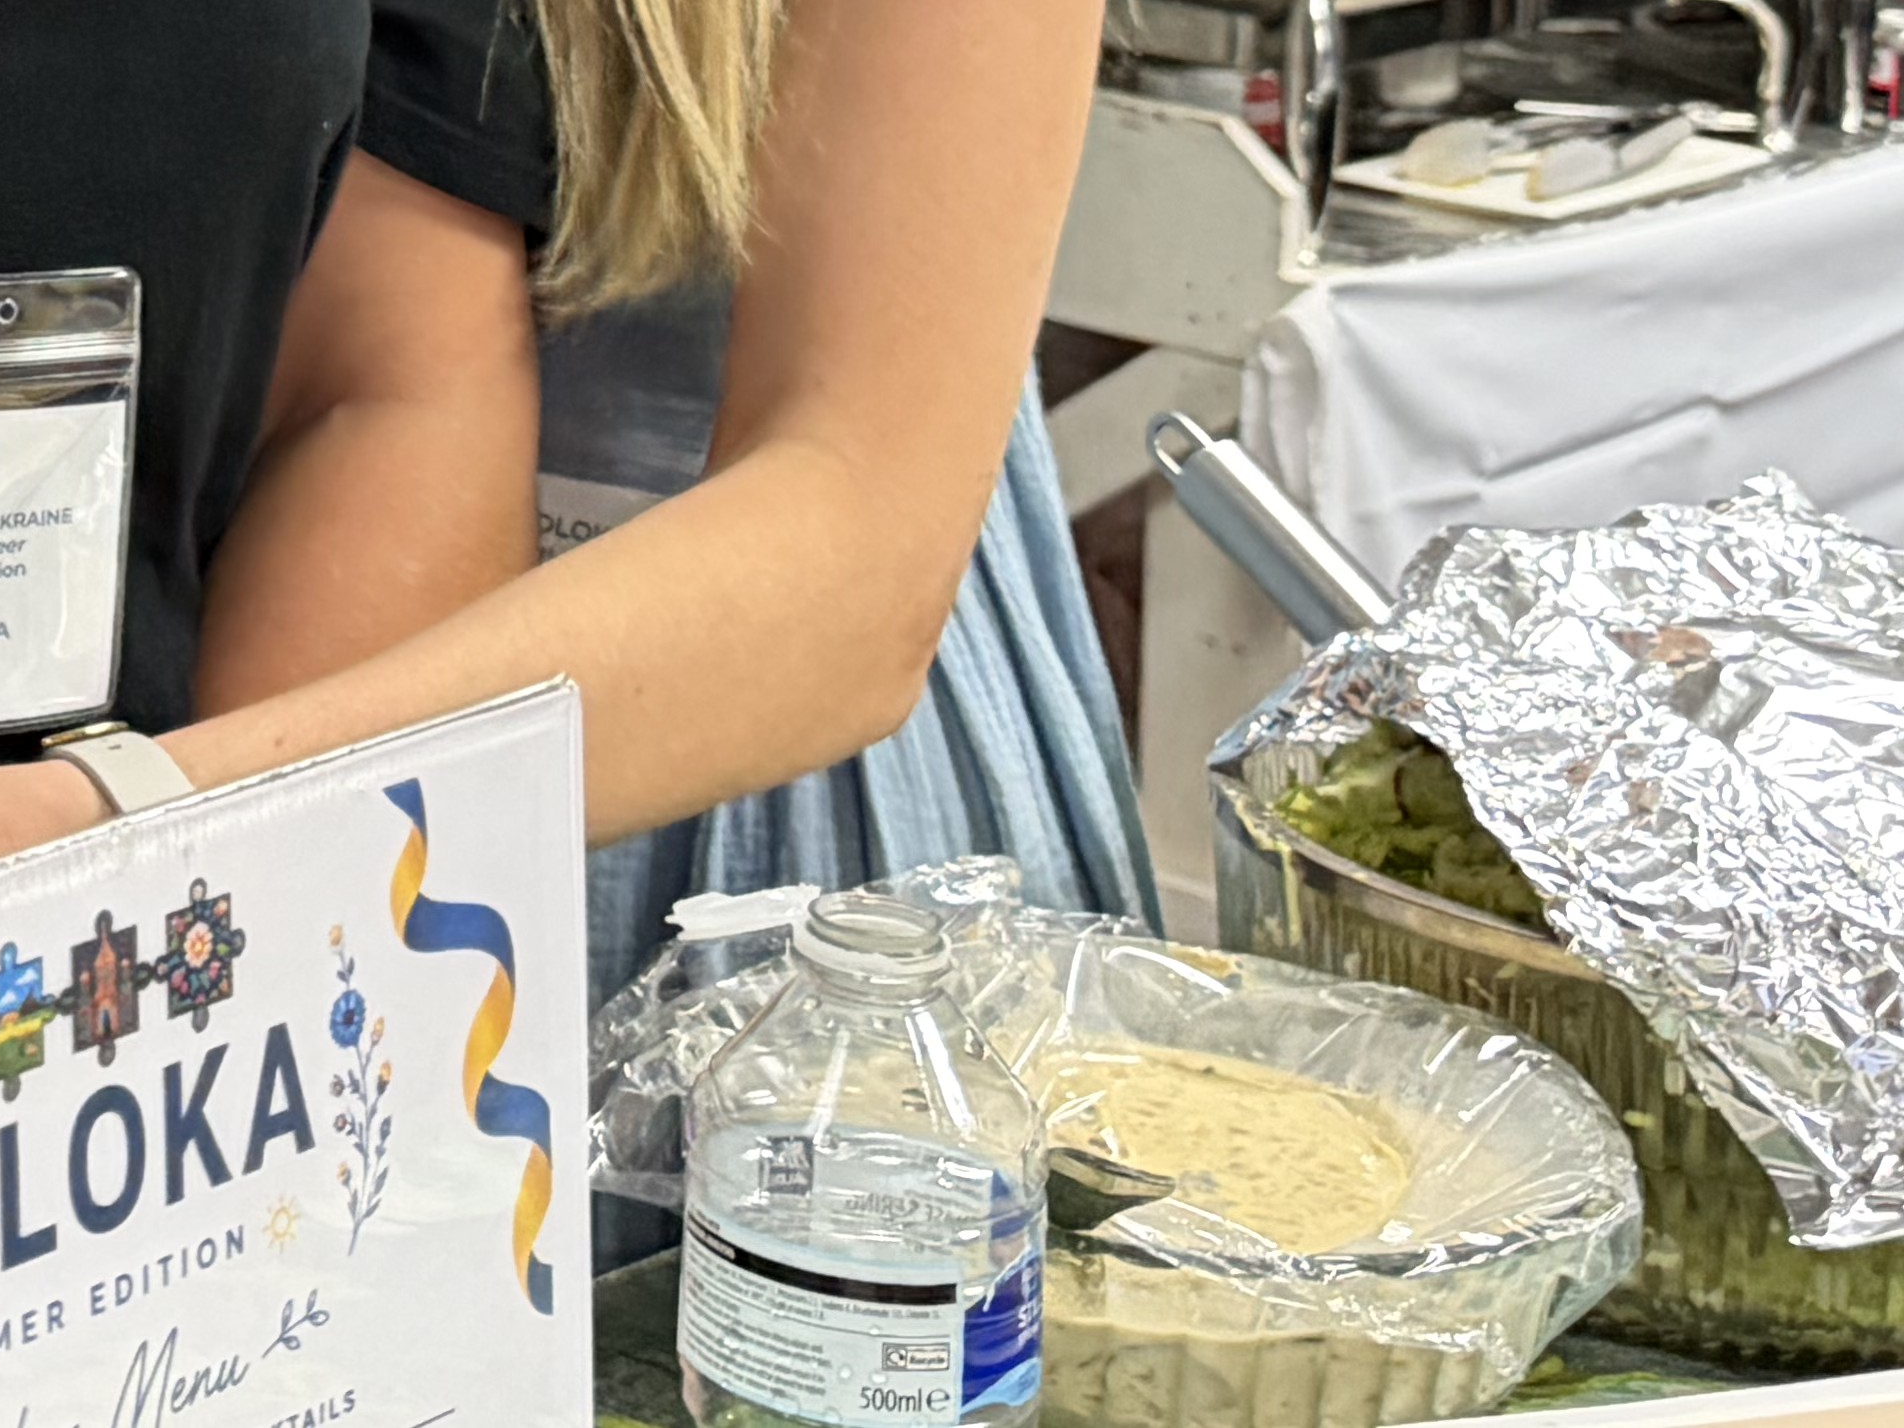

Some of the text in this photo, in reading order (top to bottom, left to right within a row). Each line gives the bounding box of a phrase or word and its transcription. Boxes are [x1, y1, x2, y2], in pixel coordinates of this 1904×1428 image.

[89, 1224, 247, 1318] EDITION
[111, 1325, 250, 1428] Menu
[858, 1386, 923, 1412] 500ml
